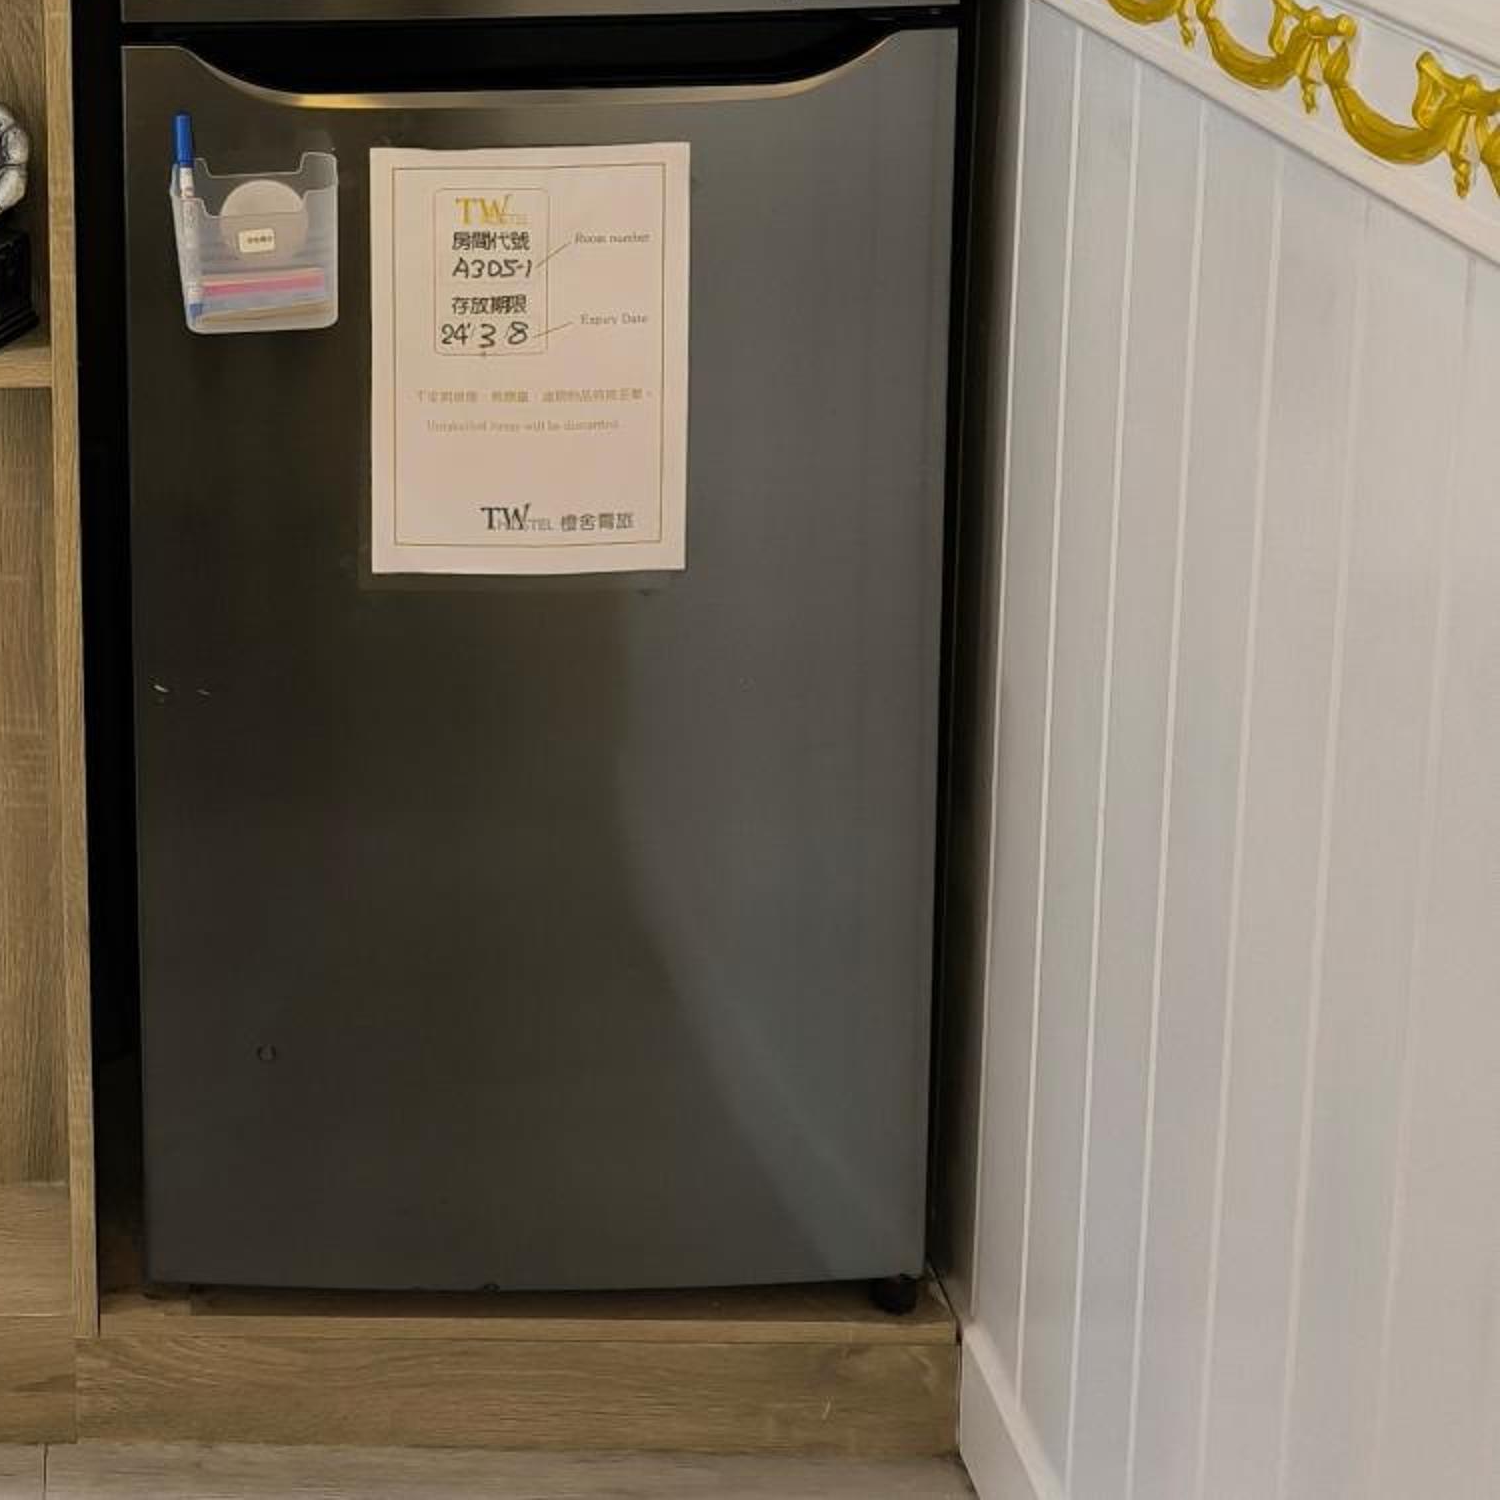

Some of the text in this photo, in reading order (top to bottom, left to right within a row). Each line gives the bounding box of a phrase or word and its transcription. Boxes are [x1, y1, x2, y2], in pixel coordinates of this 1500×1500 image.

[452, 231, 531, 251] 房間代號
[574, 231, 650, 243] Room number
[452, 294, 527, 315] 存放期限
[621, 312, 648, 324] Date
